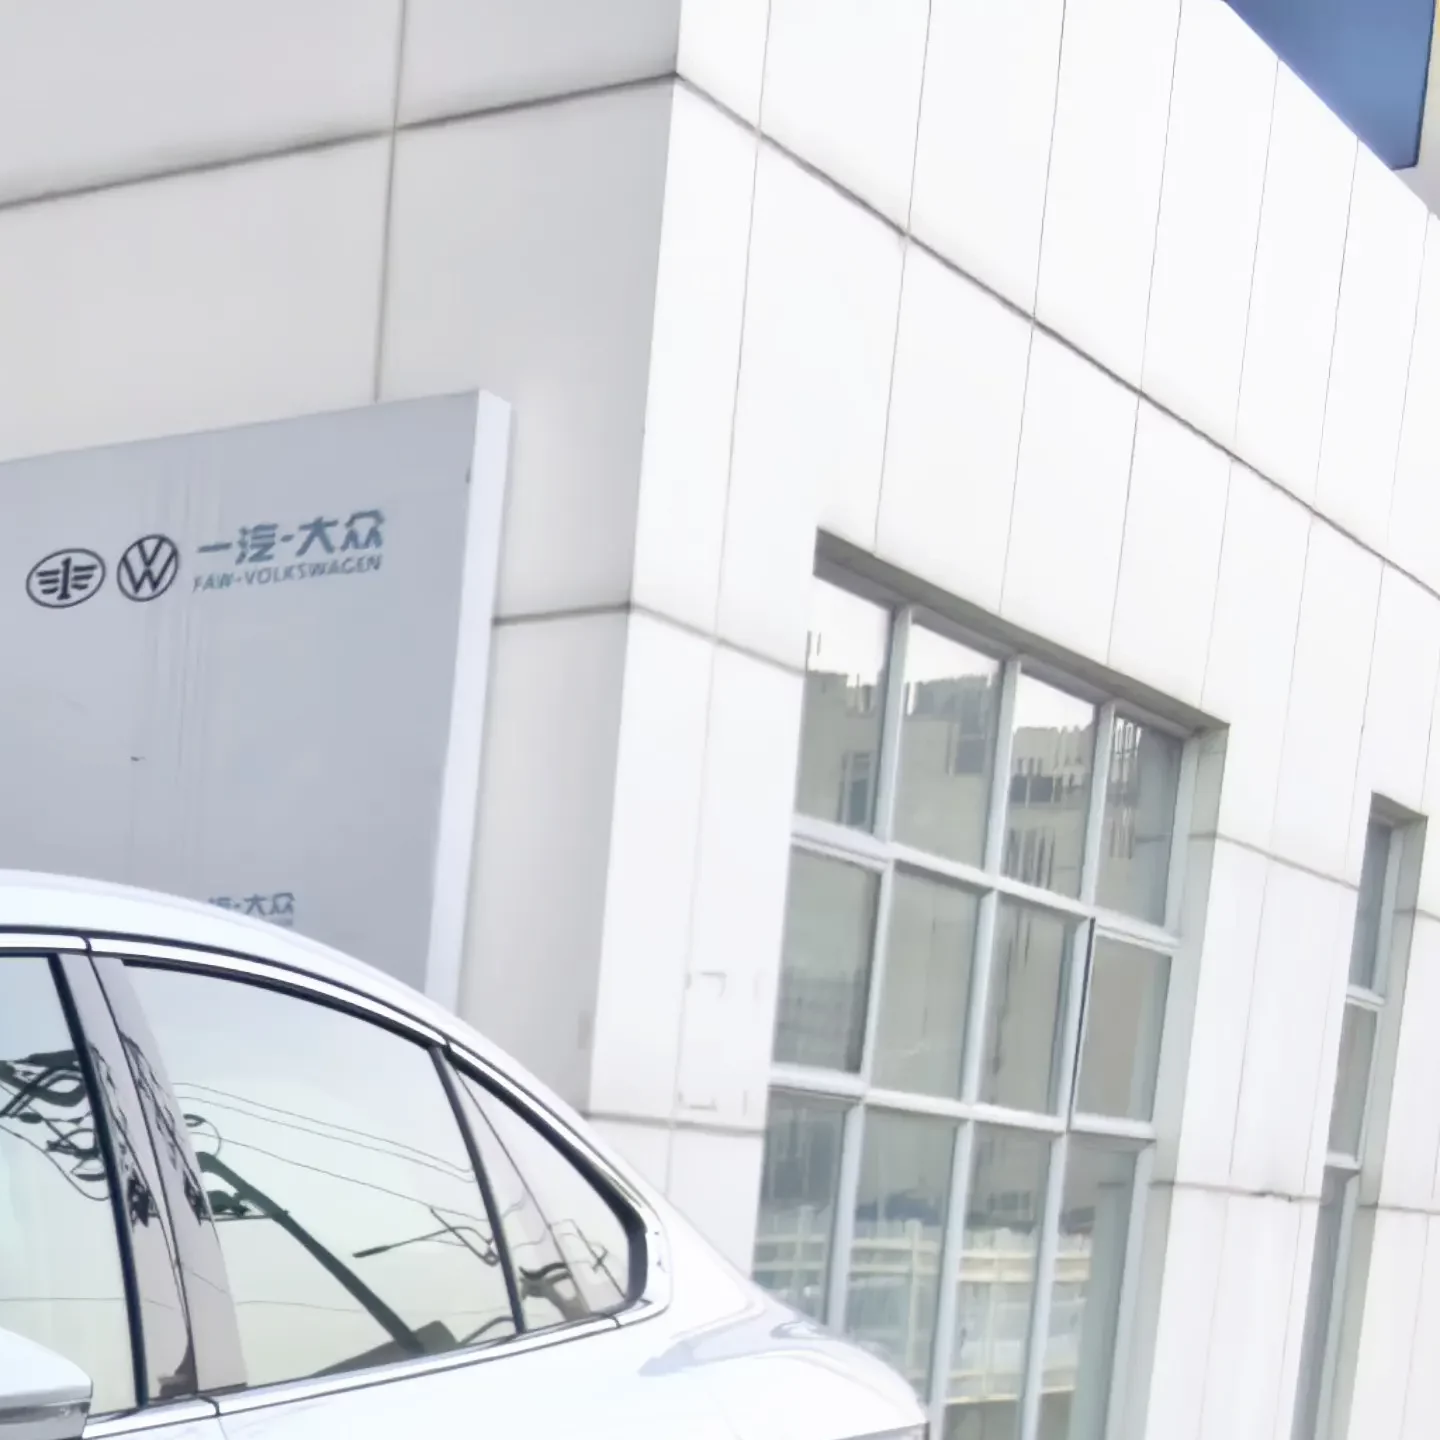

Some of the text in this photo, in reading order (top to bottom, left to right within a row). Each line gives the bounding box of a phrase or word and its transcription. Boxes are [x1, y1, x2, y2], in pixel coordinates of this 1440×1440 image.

[196, 509, 385, 566] 一汽-大众
[191, 554, 383, 593] FAW-VOLKSWAGEN
